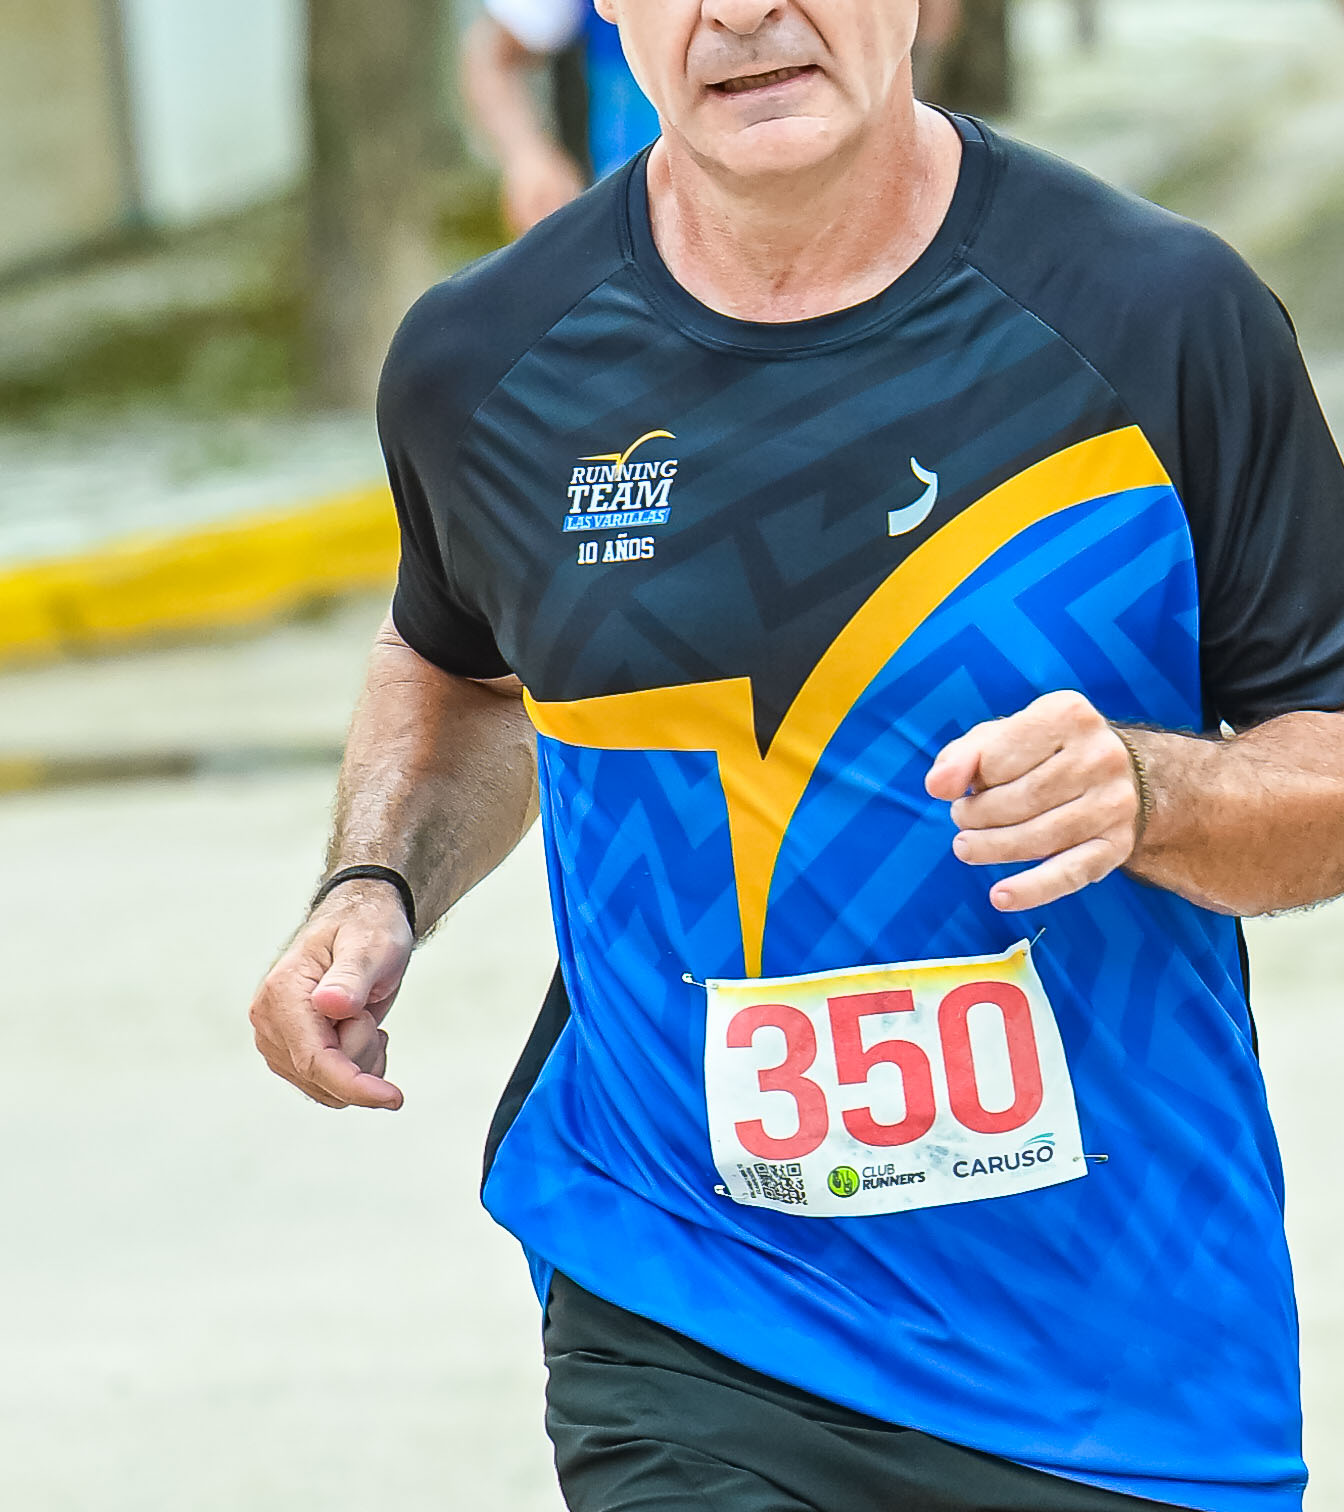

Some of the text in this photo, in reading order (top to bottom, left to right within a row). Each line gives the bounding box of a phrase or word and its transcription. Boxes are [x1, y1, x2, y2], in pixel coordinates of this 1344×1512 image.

[570, 459, 678, 484] RUNNING
[568, 478, 674, 514] TEAM
[566, 509, 667, 530] LAS VARILLAS
[577, 533, 655, 565] 10 AÑOS
[726, 981, 1044, 1161] 350
[862, 1163, 896, 1178] CLUB
[952, 1145, 1054, 1178] CARUSO
